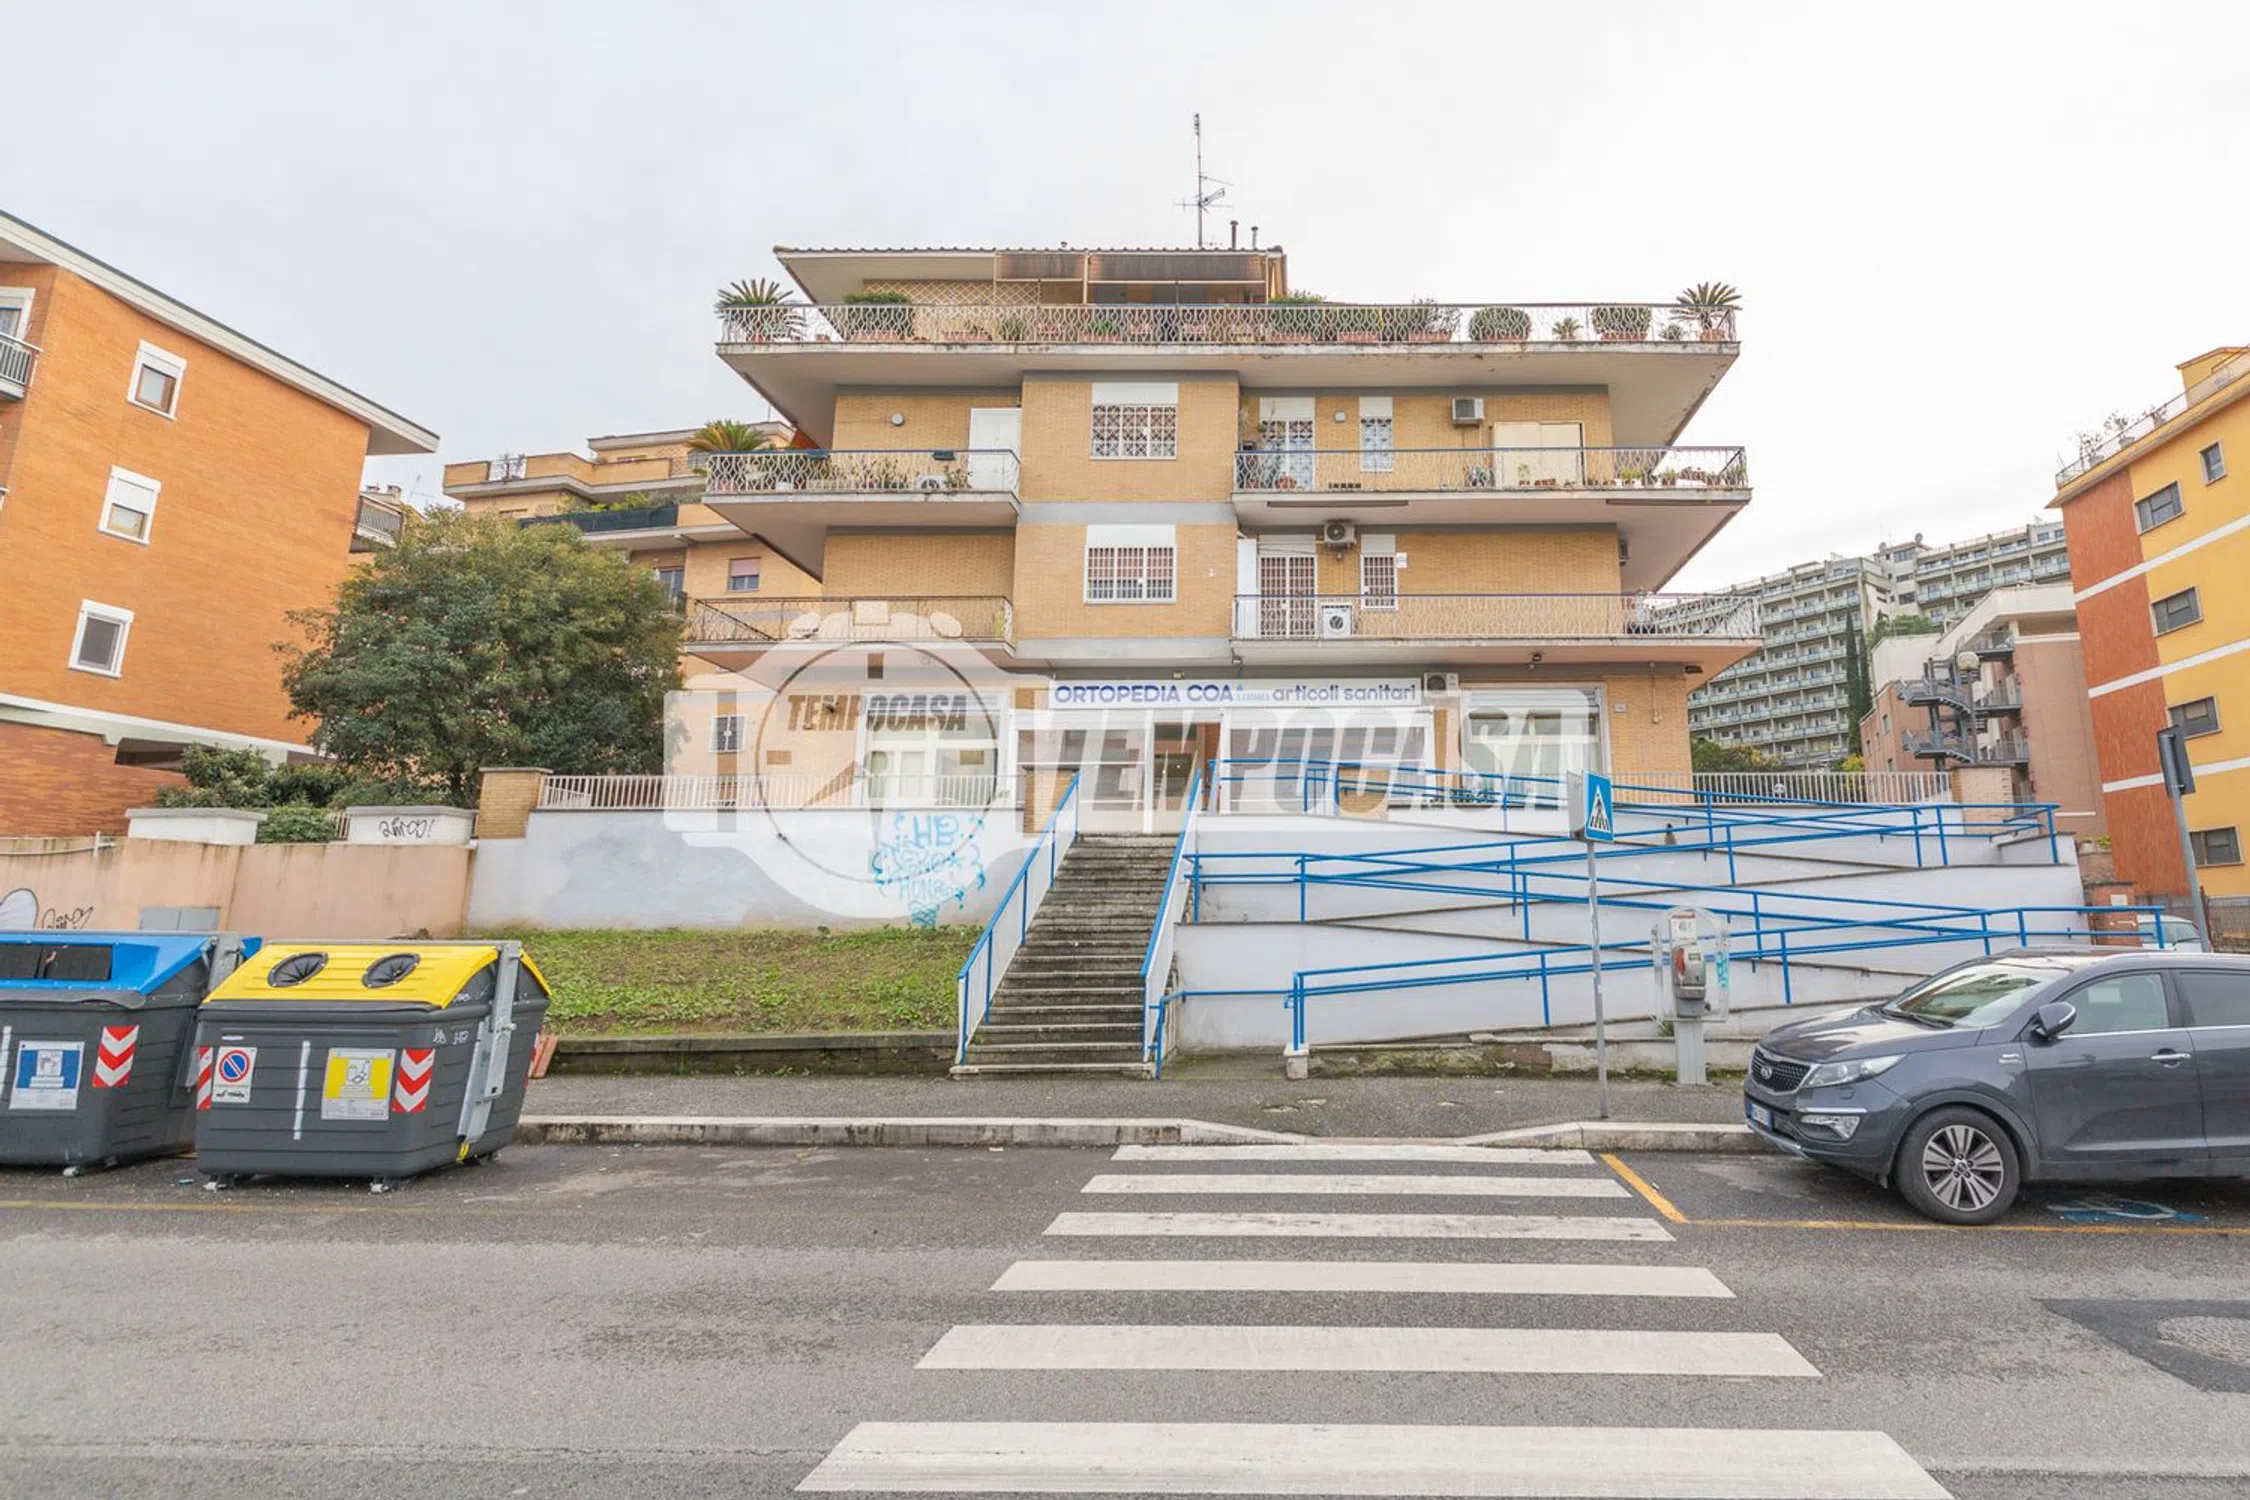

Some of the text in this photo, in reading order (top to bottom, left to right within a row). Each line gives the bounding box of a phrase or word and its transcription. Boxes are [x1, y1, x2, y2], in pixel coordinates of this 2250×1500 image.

[1054, 684, 1181, 703] ORTOPEDIA
[1186, 684, 1234, 702] COA
[1272, 684, 1340, 702] articoli
[1343, 684, 1416, 702] sanitari
